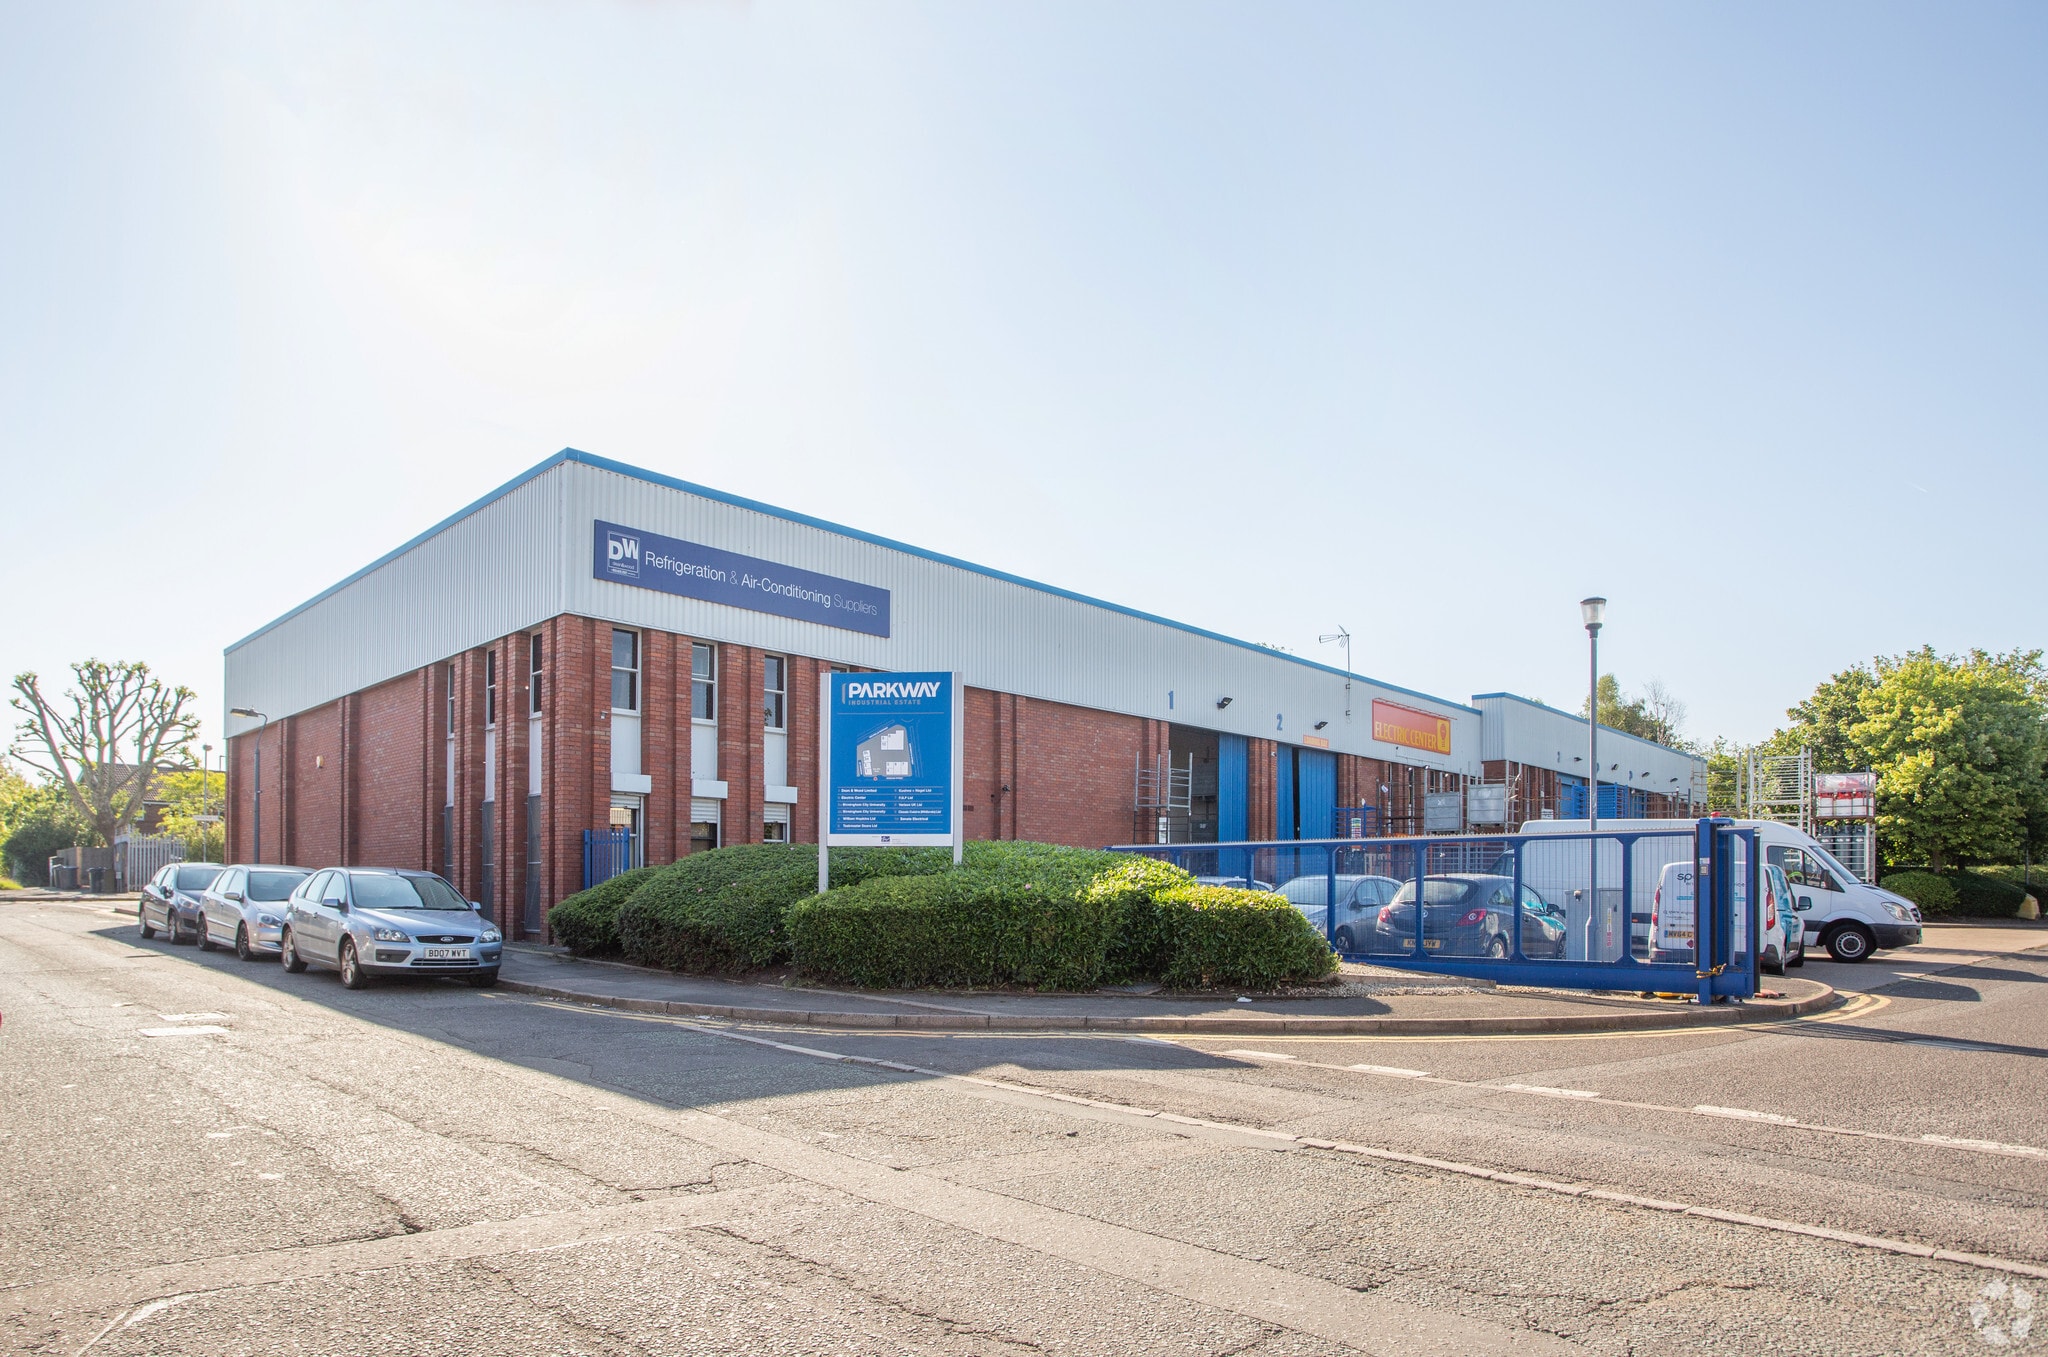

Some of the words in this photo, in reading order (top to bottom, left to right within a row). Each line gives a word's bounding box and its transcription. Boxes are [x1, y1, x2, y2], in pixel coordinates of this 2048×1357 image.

[608, 538, 639, 560] DW
[645, 551, 726, 583] Refrigeration
[729, 570, 738, 585] &
[741, 573, 831, 608] Air-Conditioning
[834, 594, 878, 616] Suppliers
[848, 681, 941, 698] PARKWAY
[1168, 690, 1174, 710] 1
[1276, 713, 1283, 731] 2
[1375, 721, 1409, 743] ELECTRIC
[1410, 729, 1437, 749] CENTER
[428, 949, 450, 957] BD07
